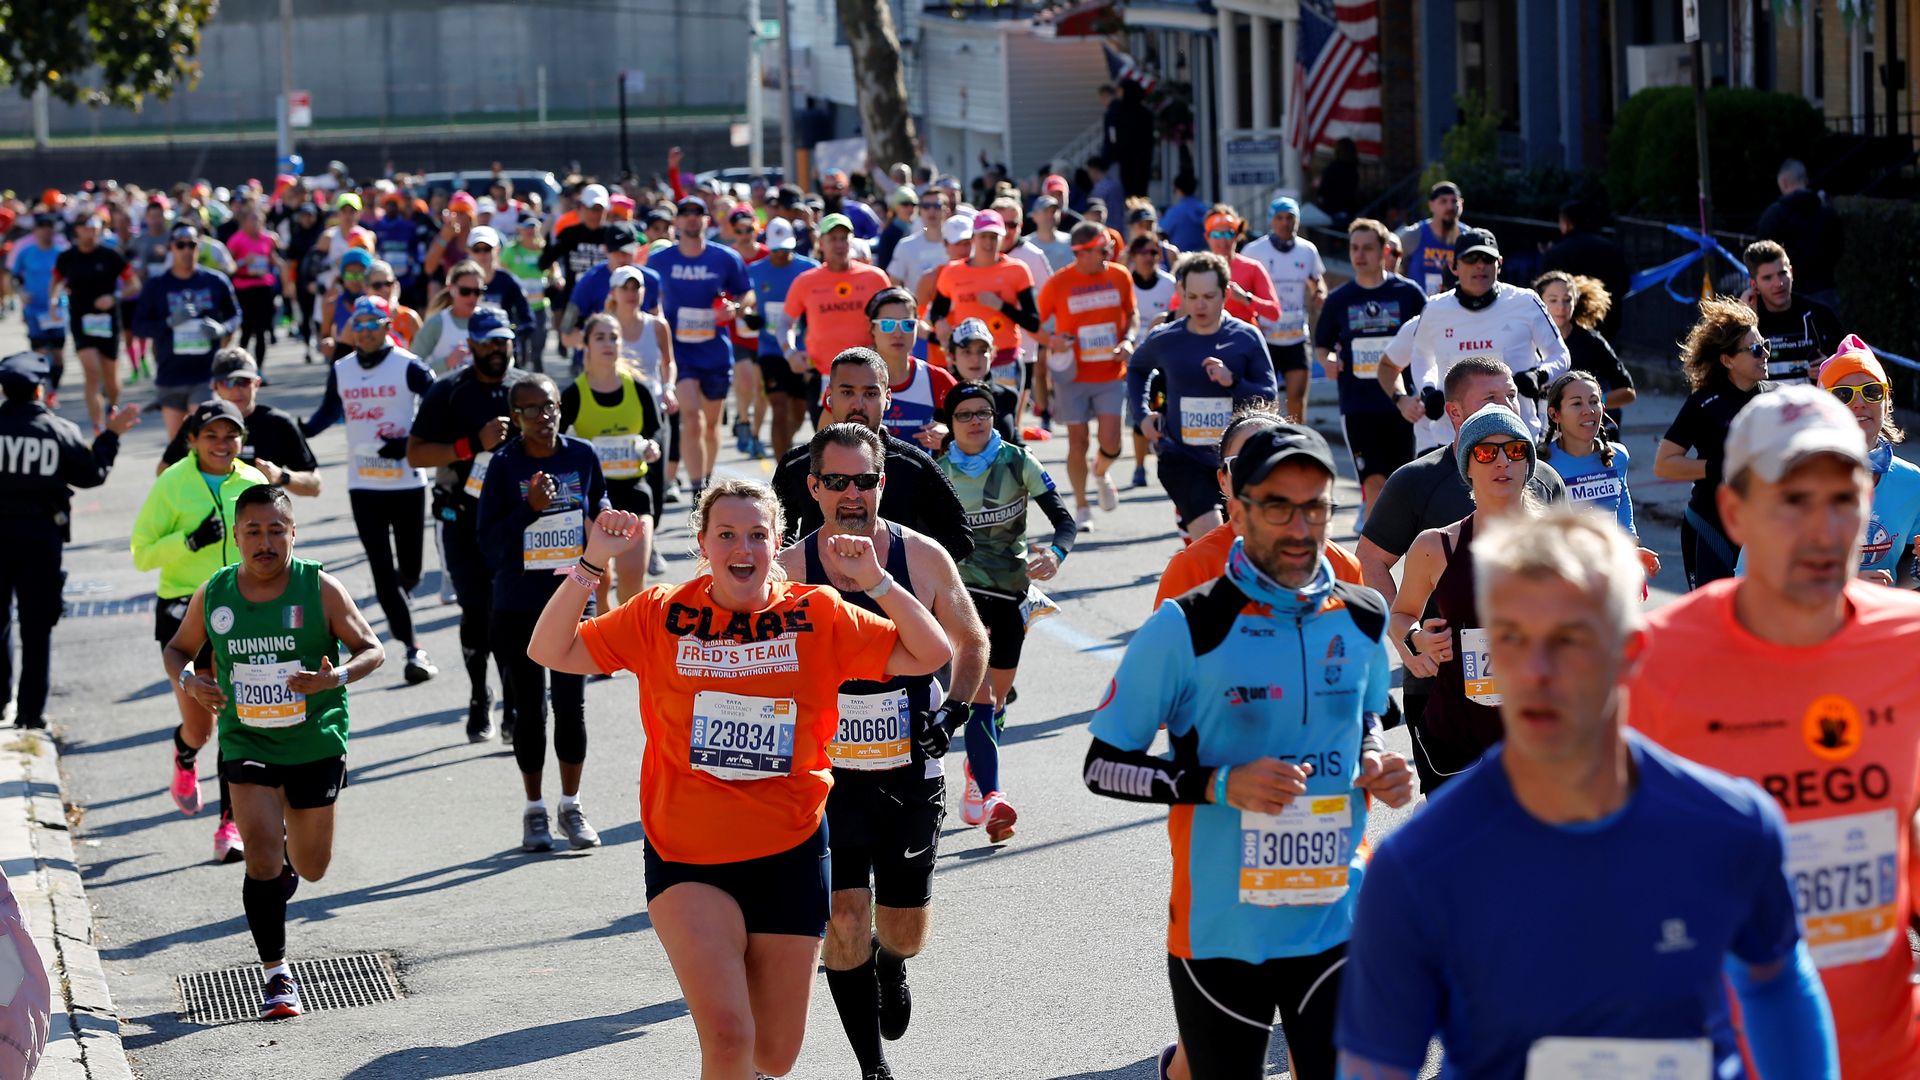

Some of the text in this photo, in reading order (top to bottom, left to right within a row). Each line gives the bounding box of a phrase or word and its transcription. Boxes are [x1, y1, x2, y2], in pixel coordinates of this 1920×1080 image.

[1459, 340, 1493, 351] FELIX
[1189, 412, 1224, 428] 29483
[0, 434, 60, 476] YPD
[1571, 481, 1615, 499] Marcia
[534, 529, 576, 548] 30058
[665, 598, 814, 643] CLARE
[227, 635, 296, 655] RUNNING
[683, 645, 740, 664] FRED'S
[745, 643, 791, 661] TEAM
[704, 670, 710, 678] A
[739, 666, 773, 677] WITHOUT
[774, 664, 799, 673] CANCER
[1466, 654, 1475, 678] 2019
[244, 684, 294, 705] 29034
[1476, 684, 1483, 692] 2
[714, 703, 753, 713] CONSULTANCY
[721, 709, 745, 717] SERVICES
[694, 719, 705, 745] 2019
[709, 720, 776, 751] 23834
[839, 716, 898, 743] 30660
[701, 752, 708, 762] 2
[835, 747, 842, 755] 2
[772, 761, 779, 769] E
[1280, 751, 1342, 778] GIS
[1085, 757, 1155, 798] PUMA
[1245, 832, 1257, 865] 2019
[1264, 831, 1337, 866] 30693
